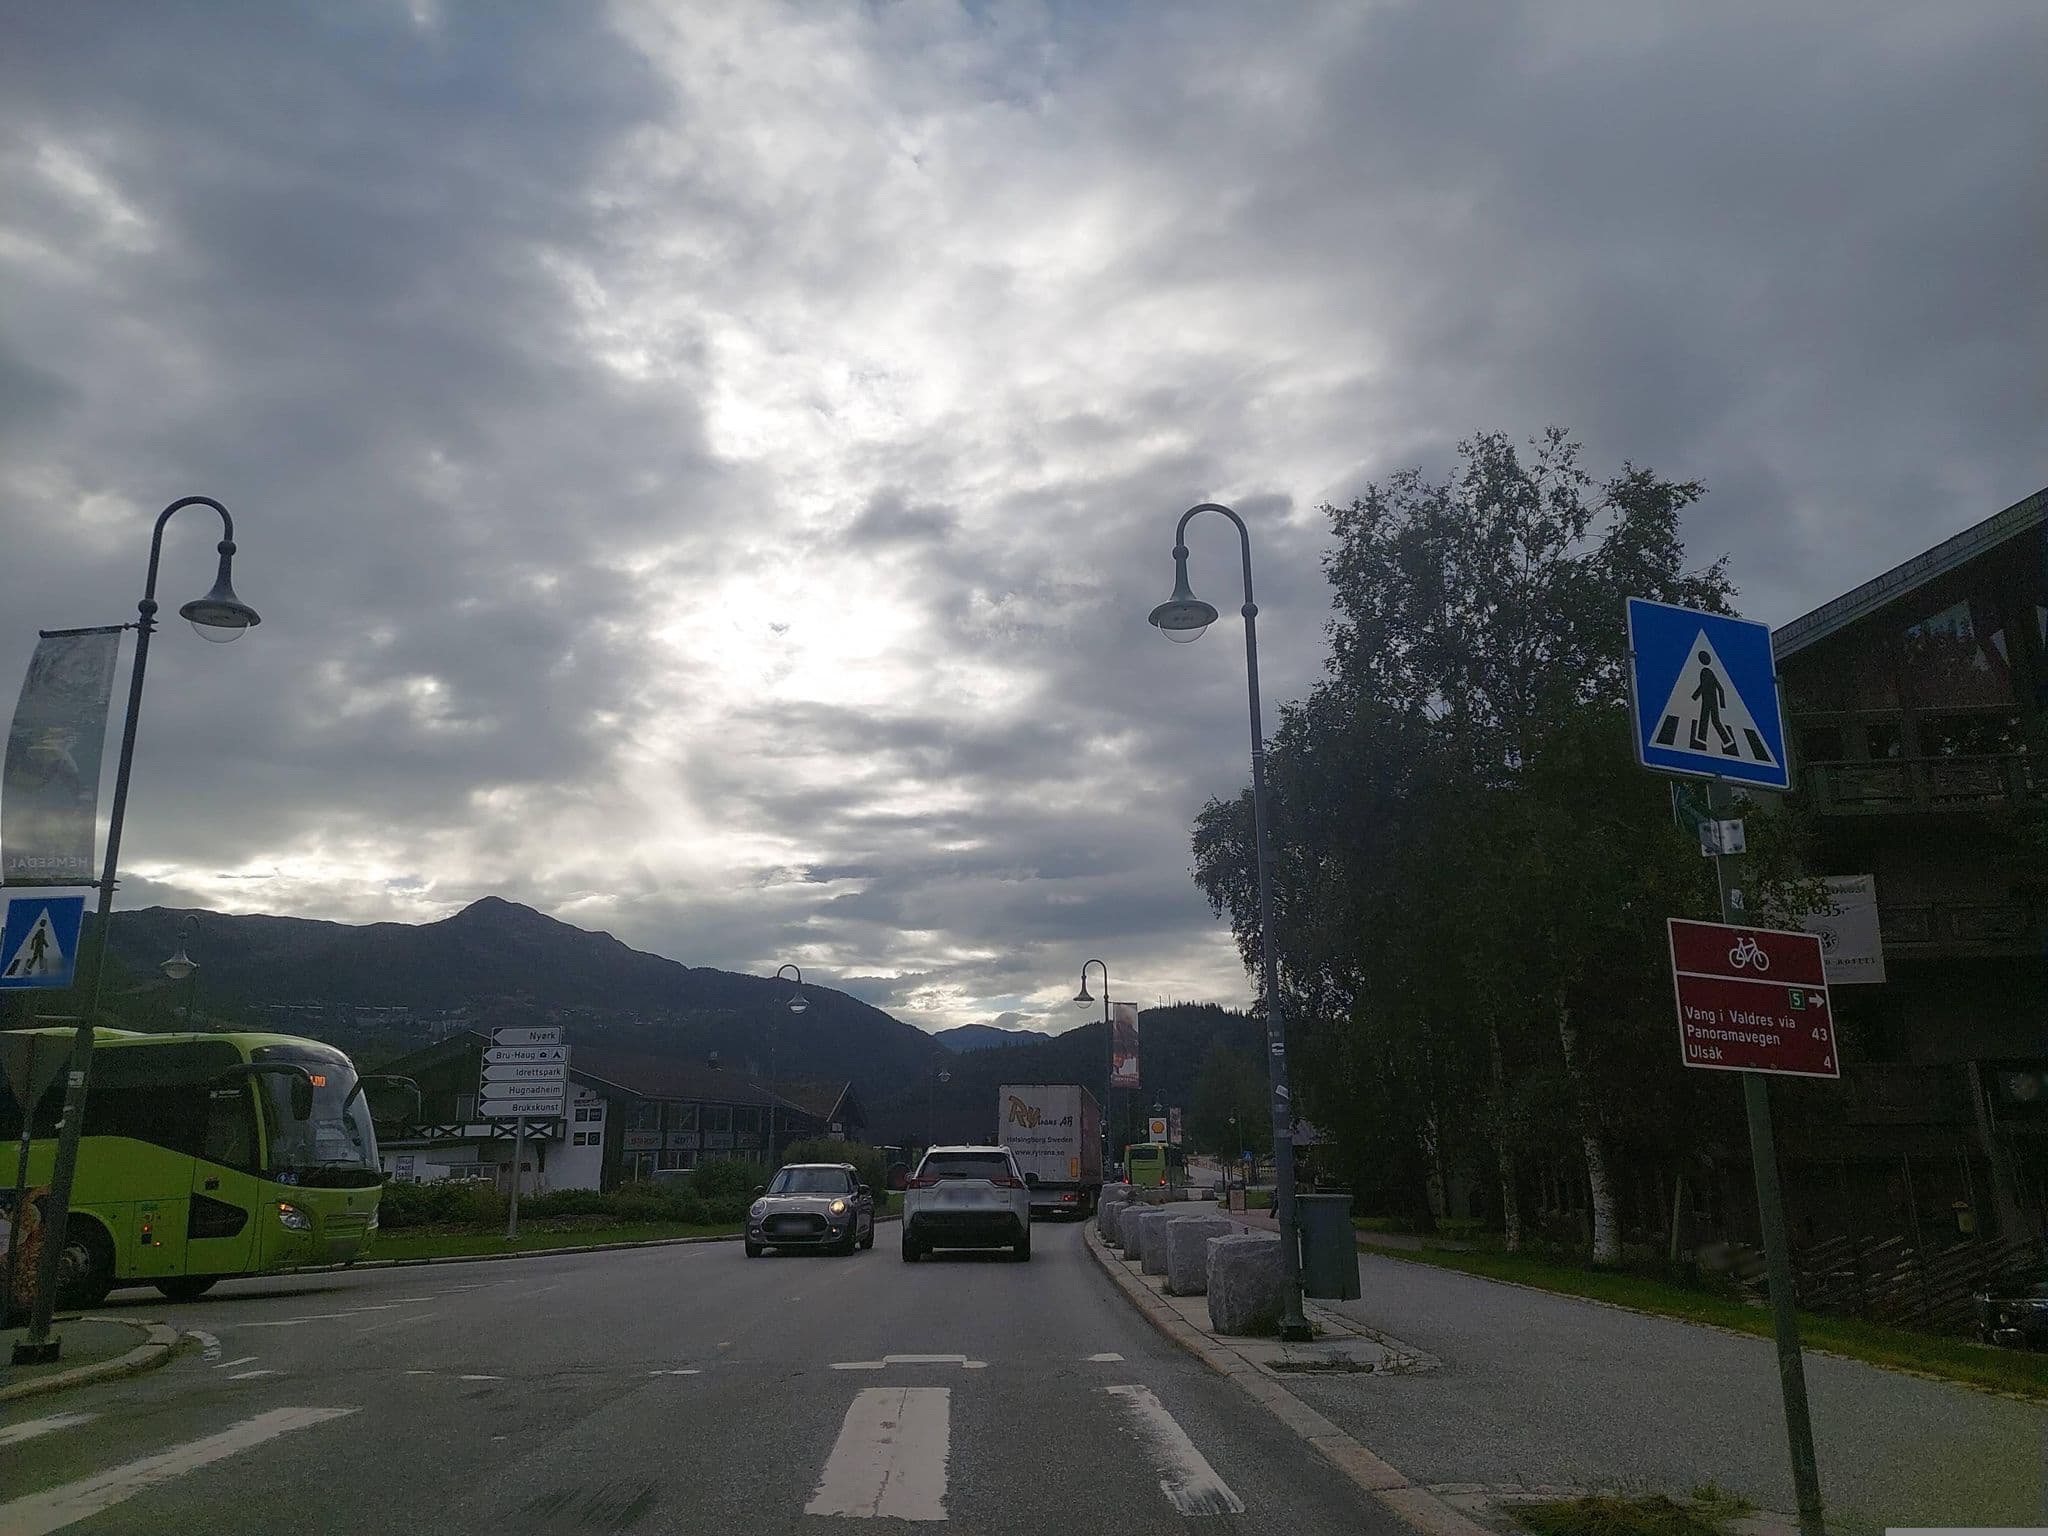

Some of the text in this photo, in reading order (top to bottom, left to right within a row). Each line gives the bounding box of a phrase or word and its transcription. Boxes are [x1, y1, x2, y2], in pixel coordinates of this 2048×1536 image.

[1684, 1006, 1796, 1029] Vang i Valdres via
[1687, 1024, 1781, 1047] Panoramavegen
[1811, 1028, 1828, 1041] 43
[1689, 1043, 1723, 1060] Ulsåk
[1823, 1056, 1831, 1069] 4
[516, 1067, 561, 1077] Idrettspark
[509, 1085, 561, 1095] Hugnadheim
[512, 1103, 559, 1112] Brukskunst
